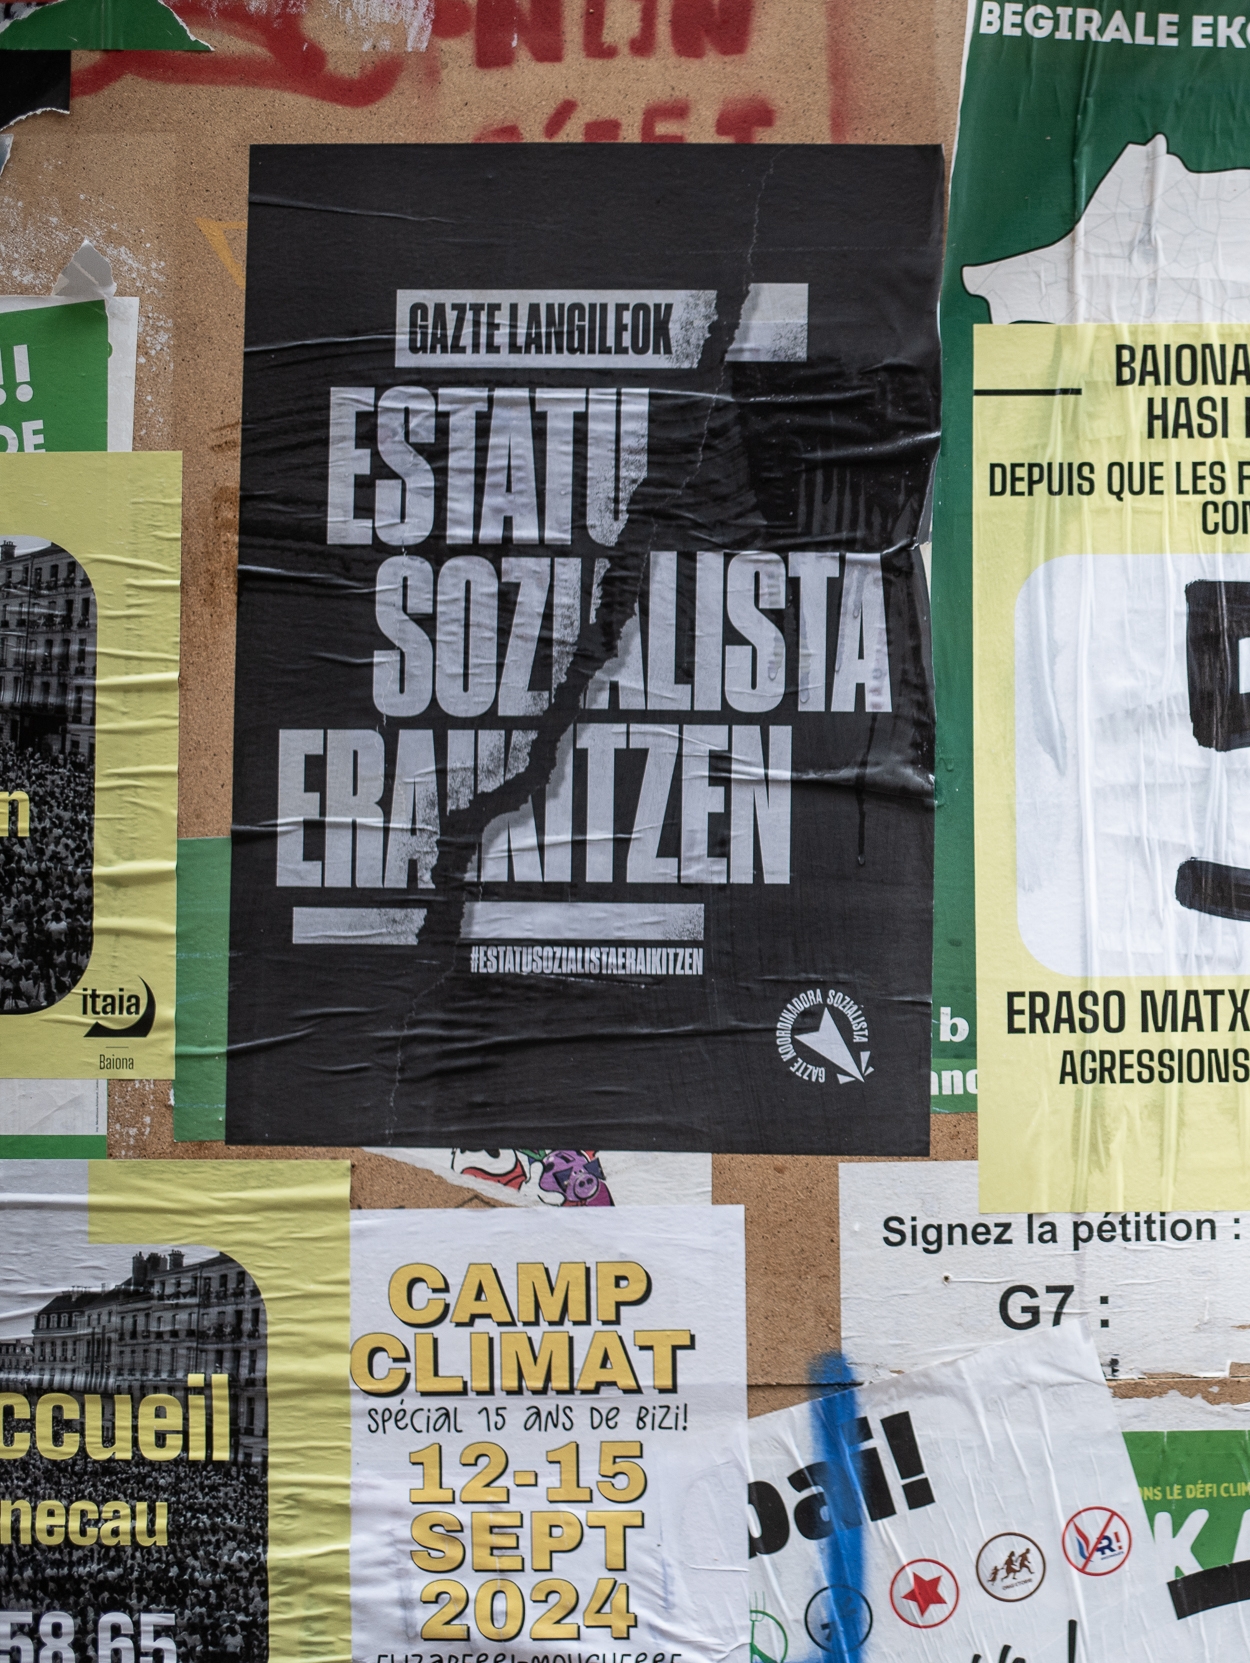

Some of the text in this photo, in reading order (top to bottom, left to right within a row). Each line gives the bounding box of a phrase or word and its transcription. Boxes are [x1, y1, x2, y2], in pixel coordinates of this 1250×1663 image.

[979, 1, 1179, 46] BEGIRALE
[408, 303, 673, 356] GAZTE LANGILEOK
[1146, 396, 1229, 440] HASI
[326, 386, 650, 546] ESTATU
[988, 461, 1095, 496] DEPUIS
[1106, 461, 1165, 502] QUE
[1174, 460, 1226, 495] LES
[372, 550, 892, 717] SOZIALISTA
[470, 945, 704, 975] #ESTATUSOZIALISTAERAIKITZEN
[81, 988, 141, 1016] itaia
[1006, 990, 1126, 1034] ERASO
[776, 988, 869, 1083] GAZTE KOORDINADORA SOZIALISTA
[99, 1053, 134, 1071] Baiona
[1059, 1047, 1250, 1085] AGRESSIONS
[882, 1214, 1013, 1255] Signez
[1026, 1213, 1059, 1244] la
[1072, 1211, 1218, 1251] pétition
[388, 1260, 652, 1328] CAMP
[998, 1284, 1076, 1331] G7
[350, 1329, 696, 1397] CLIMAT
[478, 1406, 507, 1432] 15
[408, 1441, 648, 1505] 12-15
[1166, 1484, 1182, 1500] LE
[1186, 1480, 1217, 1499] DÉFI
[409, 1510, 645, 1573] SEPT
[419, 1577, 638, 1642] 2024
